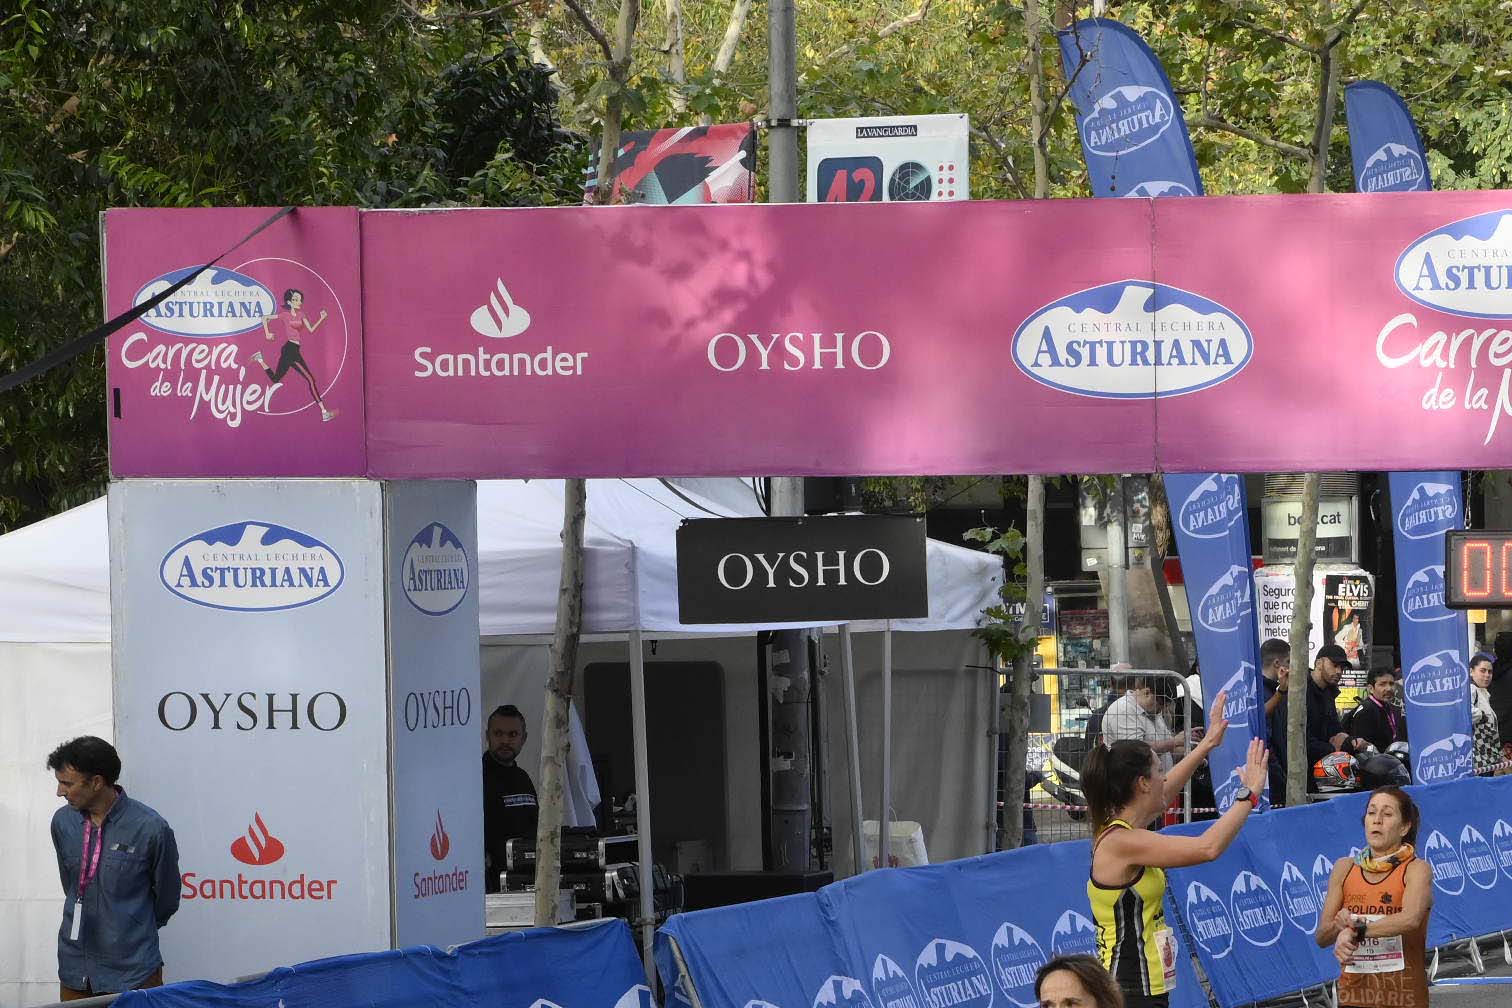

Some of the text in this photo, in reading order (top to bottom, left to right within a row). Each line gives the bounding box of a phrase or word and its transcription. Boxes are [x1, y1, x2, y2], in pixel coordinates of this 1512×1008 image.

[1068, 320, 1226, 333] CENTRAL LECHERA
[121, 332, 238, 369] Carrera
[414, 347, 588, 377] Santander
[707, 331, 891, 372] OYSHO
[1030, 325, 1234, 368] ASTURIANA
[151, 371, 193, 397] de la
[189, 367, 283, 427] Mujer
[1421, 369, 1489, 410] de la
[175, 555, 331, 588] ASTURIANA
[203, 552, 324, 562] CENTRAL LECHERA
[718, 548, 890, 590] OYSHO
[408, 556, 465, 593] ASTURIANA
[1338, 583, 1369, 597] ELVIS
[1263, 600, 1281, 611] que
[1264, 627, 1290, 637] mete
[158, 691, 347, 731] OYSHO
[405, 687, 471, 732] OYSHO
[181, 872, 338, 900] Santander
[413, 866, 469, 900] Santander
